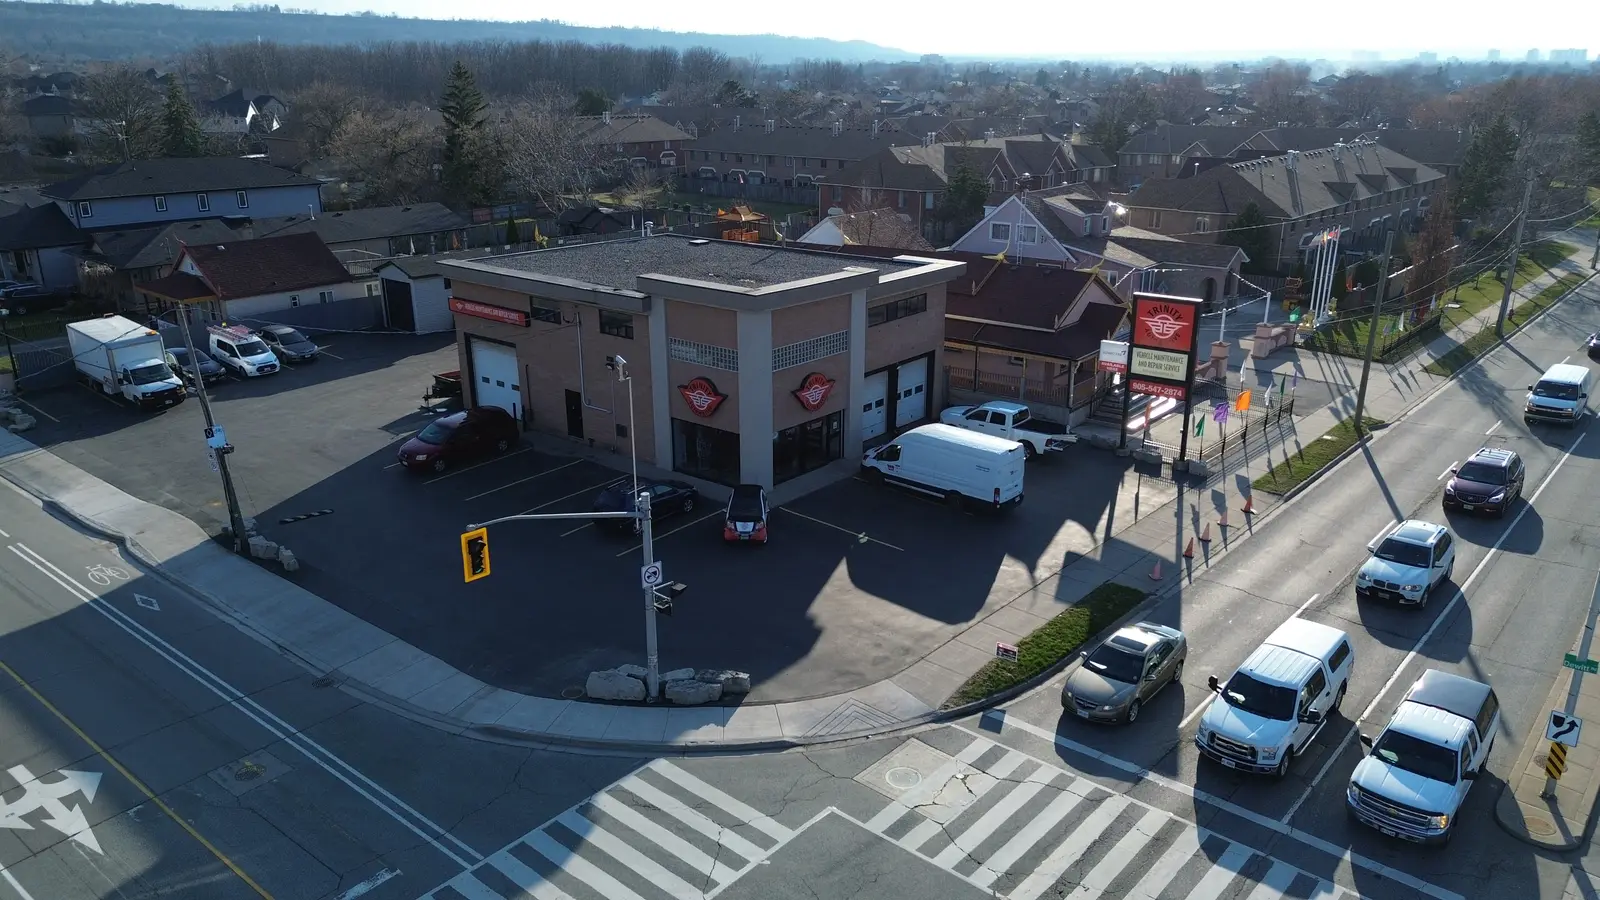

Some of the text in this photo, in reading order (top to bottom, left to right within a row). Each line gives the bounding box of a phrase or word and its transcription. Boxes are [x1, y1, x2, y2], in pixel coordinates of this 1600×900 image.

[1147, 304, 1183, 320] TRINITY
[1136, 351, 1184, 365] VEHICLE MAINTENANCE
[1148, 361, 1163, 370] REPAIR
[1163, 363, 1180, 373] SERVICE
[689, 382, 712, 395] TRINITY
[806, 376, 825, 390] TRINITY
[1132, 382, 1182, 396] 905-547-2874
[1564, 660, 1589, 672] Dewitt
